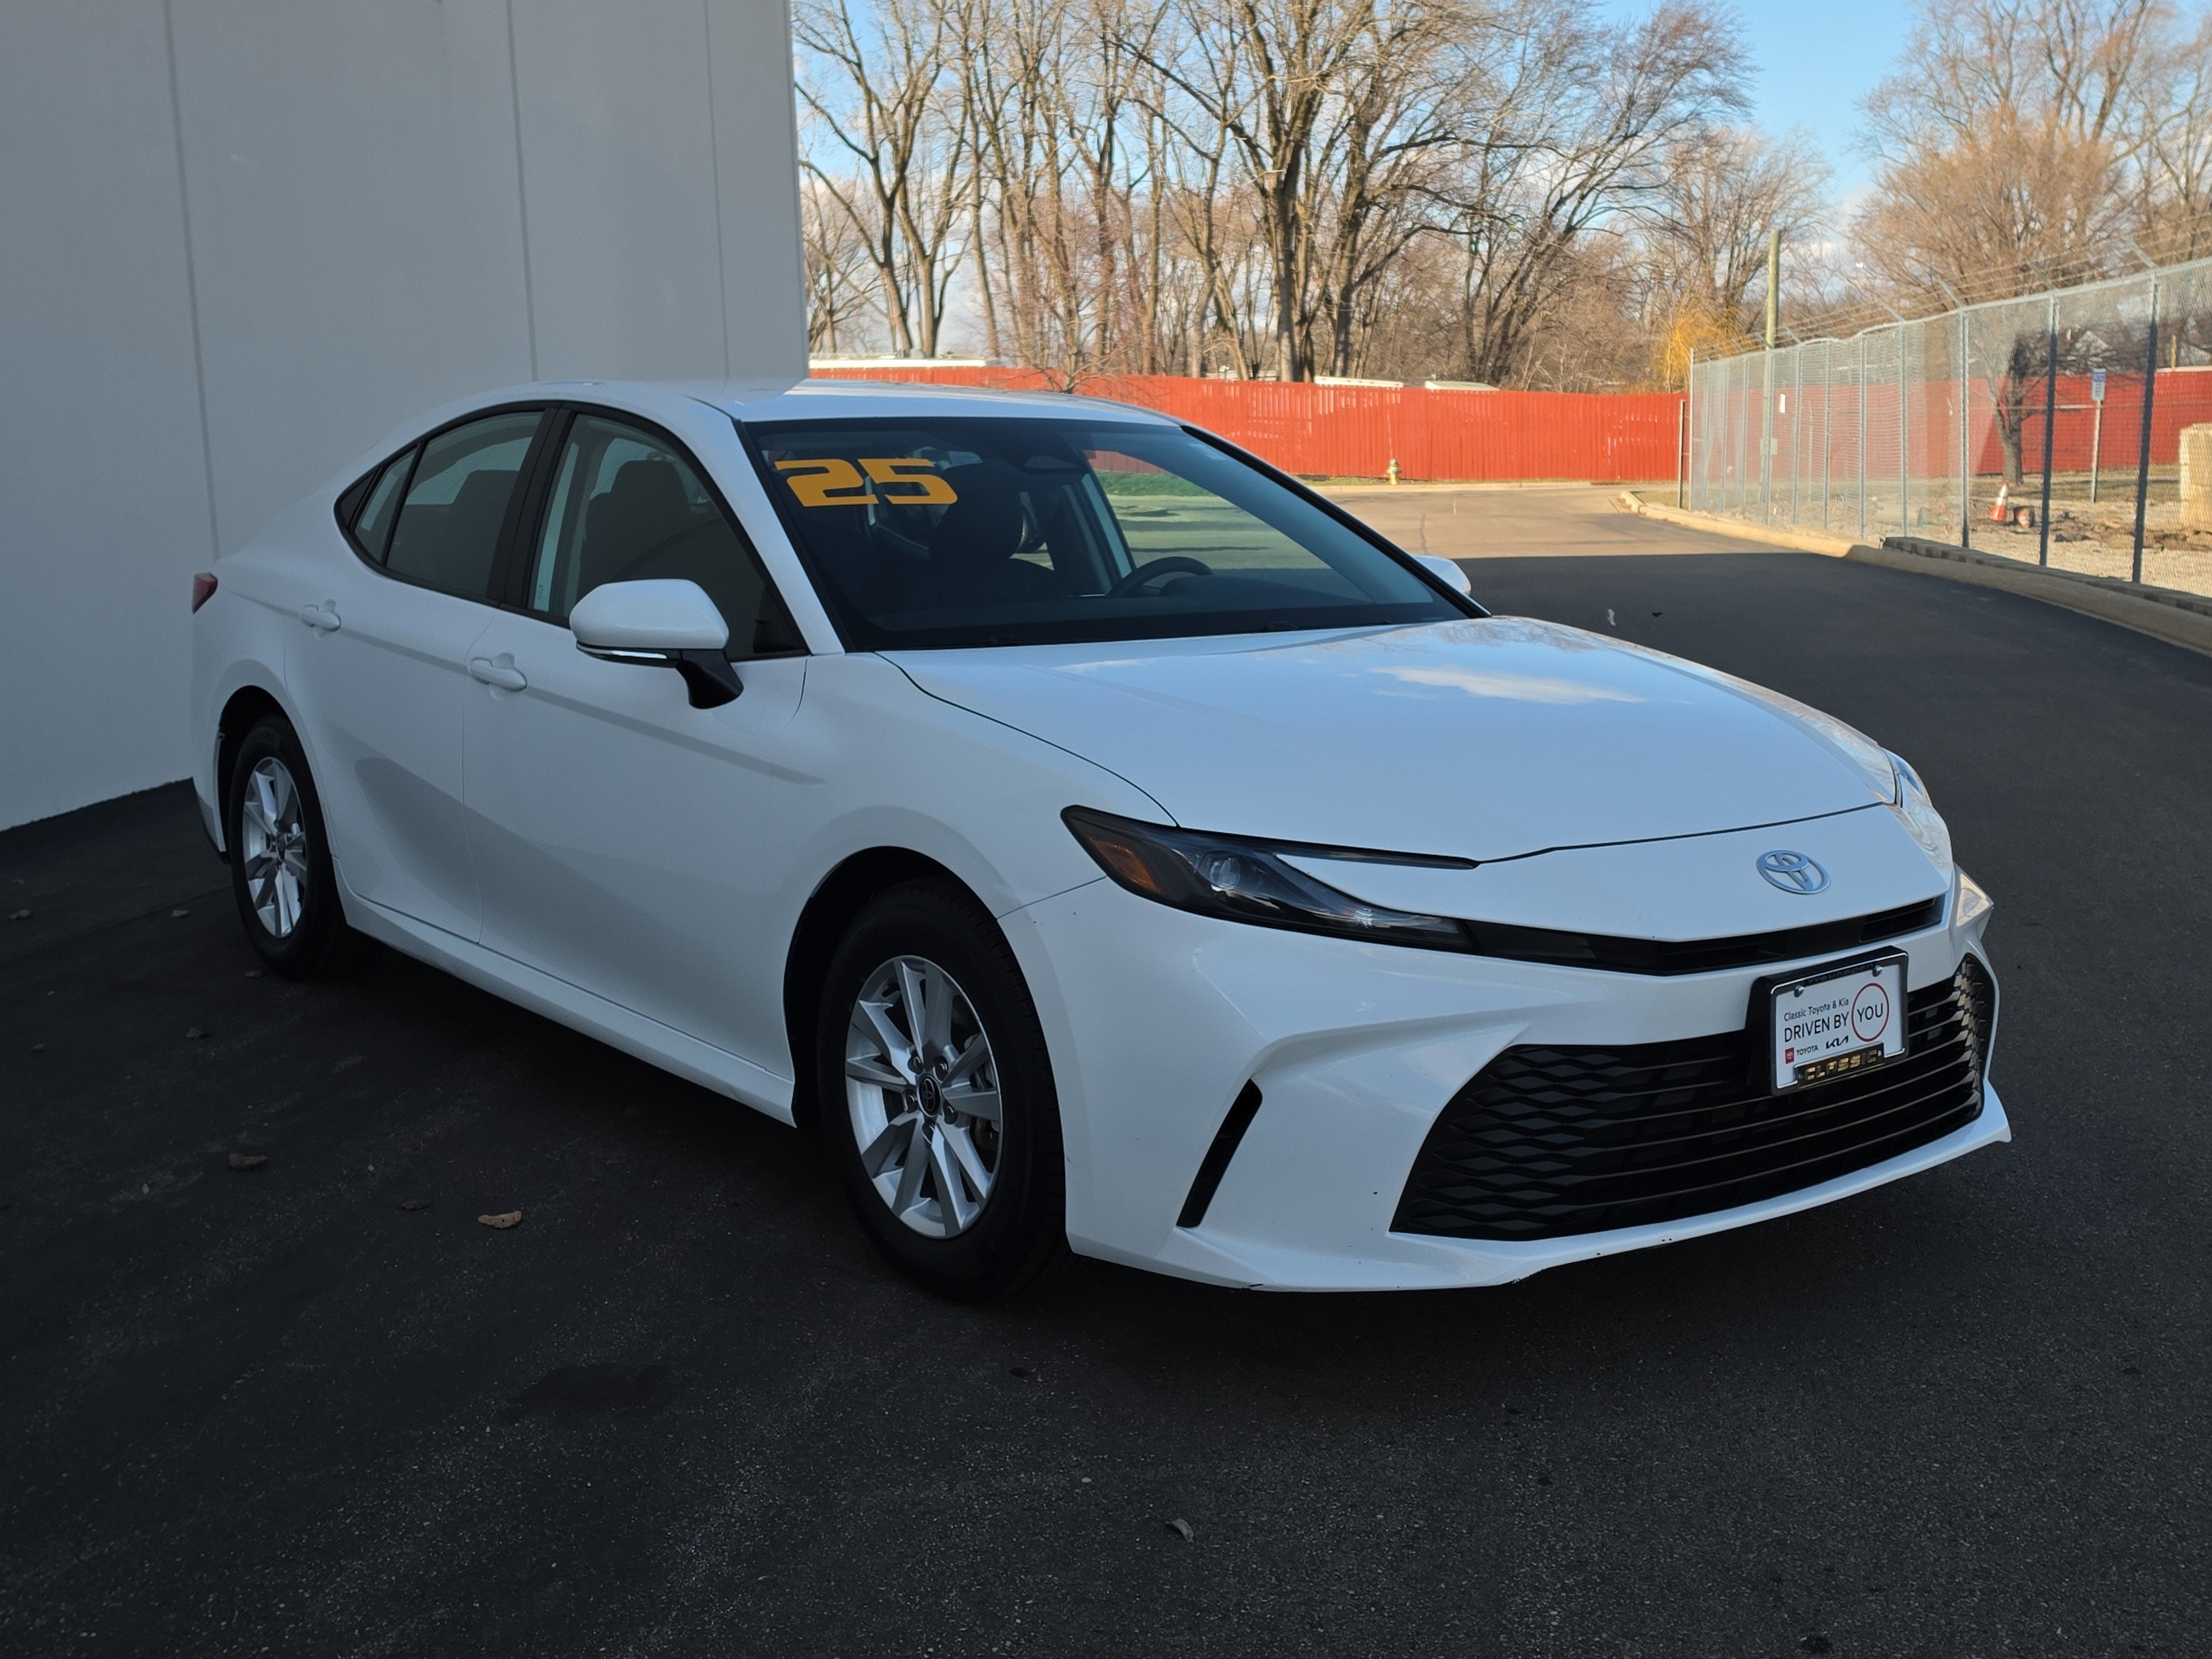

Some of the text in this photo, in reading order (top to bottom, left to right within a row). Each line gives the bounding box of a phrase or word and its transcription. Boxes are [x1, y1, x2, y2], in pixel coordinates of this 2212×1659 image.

[774, 459, 958, 507] 25
[1784, 998, 1849, 1021] Classic Toyota & Kia
[1784, 1003, 1883, 1043] DRIVEN BY YOU
[1796, 1044, 1819, 1056] TOYOTA
[1804, 1050, 1877, 1081] CLASSIC
